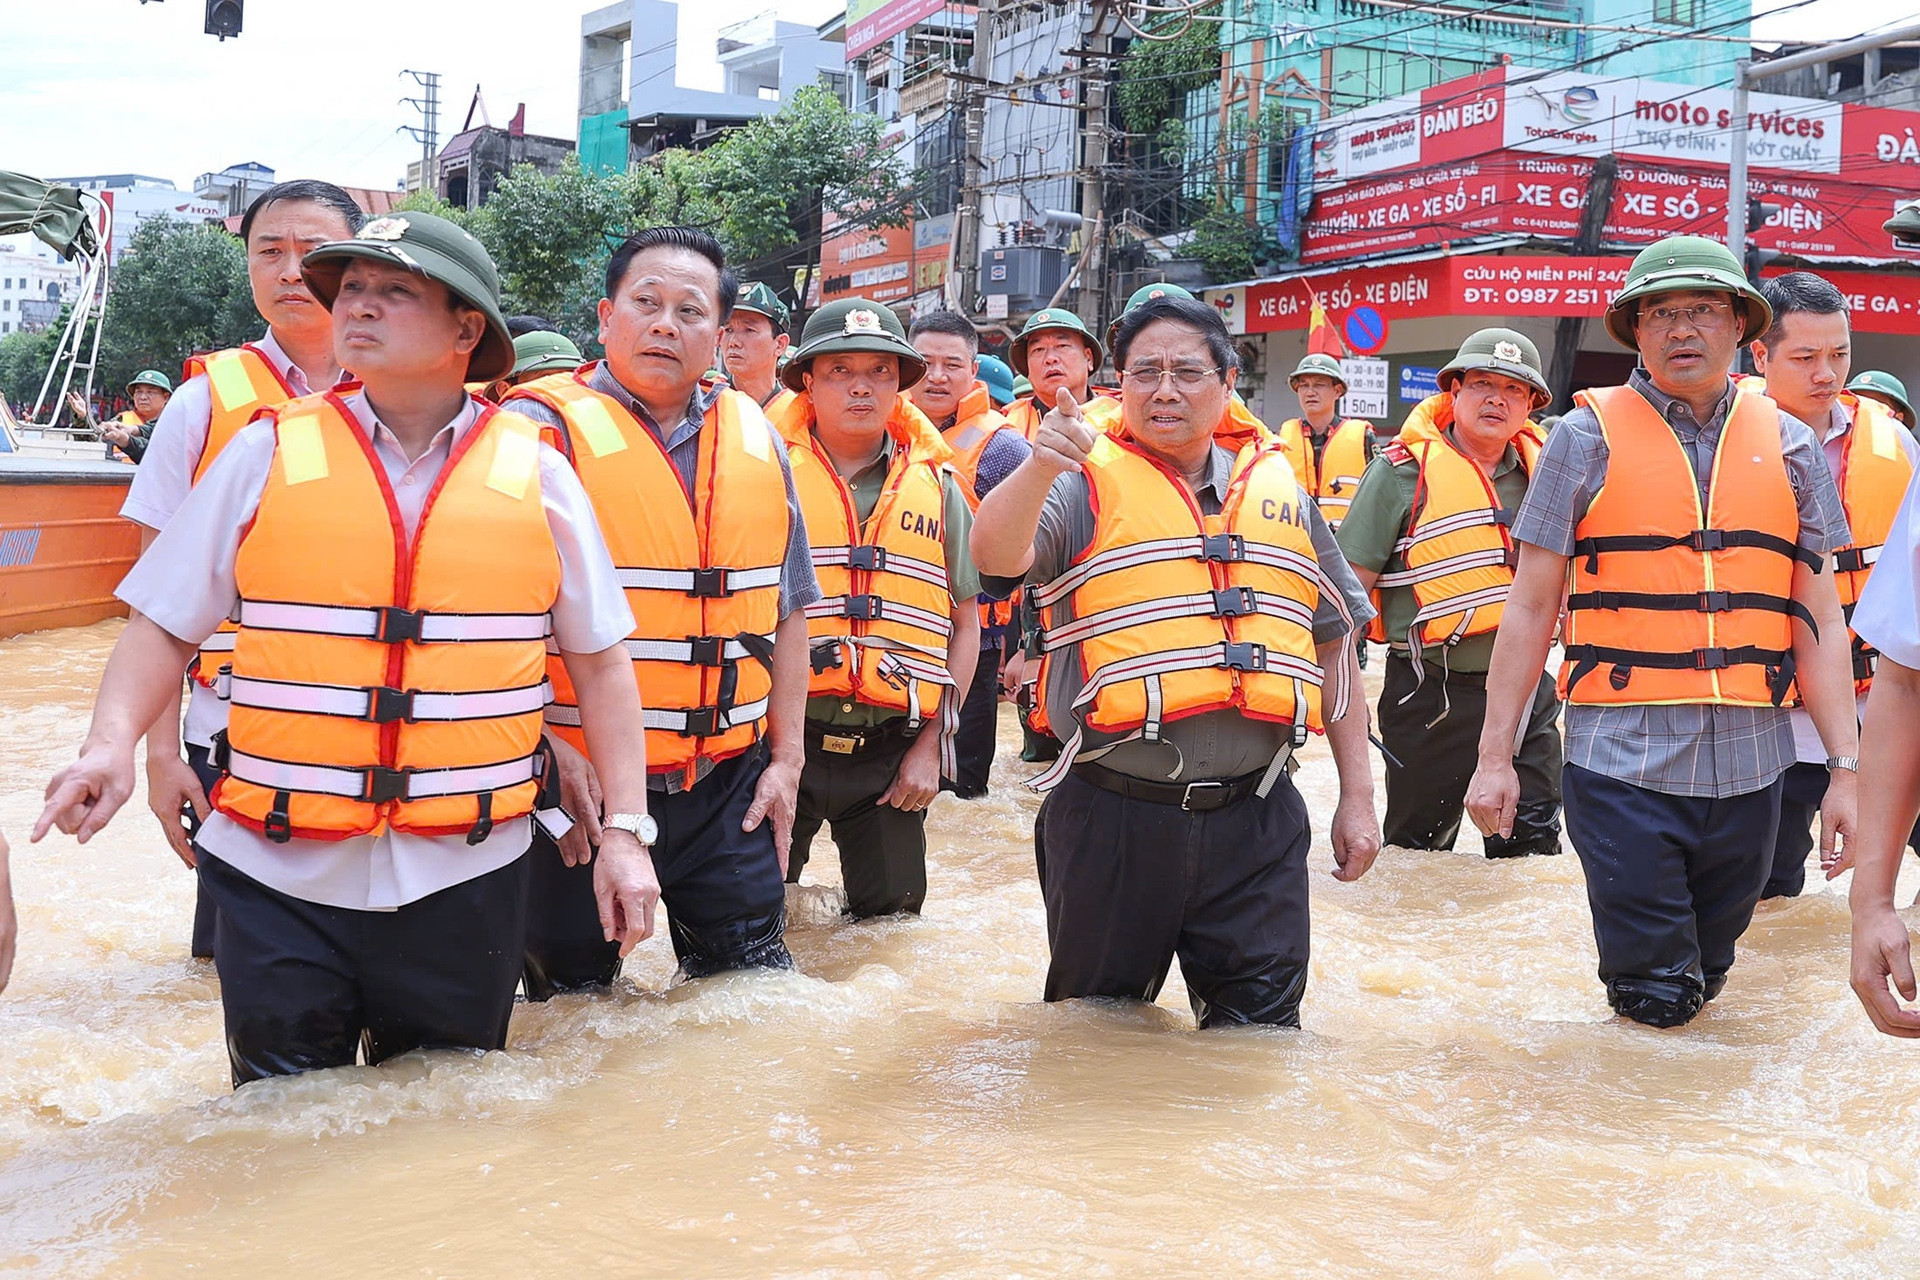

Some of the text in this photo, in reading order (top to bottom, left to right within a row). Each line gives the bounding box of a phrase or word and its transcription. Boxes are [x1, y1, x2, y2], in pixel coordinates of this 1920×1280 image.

[1423, 105, 1459, 138] ĐÀN
[1636, 100, 1824, 139] moto srvices
[1525, 126, 1598, 144] TotalEnergies
[1518, 160, 1567, 175] TRUNG
[1368, 203, 1386, 228] XE
[1389, 203, 1410, 223] GA
[1422, 194, 1442, 218] XE
[1445, 181, 1467, 213] SỐ
[1481, 185, 1497, 207] FI
[1517, 183, 1552, 207] XE
[1623, 192, 1657, 216] XE
[1664, 188, 1700, 219] SỐ
[1463, 266, 1495, 281] CỨU
[1500, 266, 1522, 283] HỘ
[1526, 265, 1563, 281] MIỄN
[1568, 266, 1593, 281] PHÍ
[1259, 298, 1275, 317] XE
[1278, 296, 1298, 315] GA
[1310, 291, 1329, 312] XE
[1331, 280, 1352, 309] SỐ
[1366, 282, 1385, 304] XE
[1389, 274, 1428, 306] ĐIỆN
[1464, 288, 1499, 303] ĐT:
[1505, 288, 1560, 304] 0987
[1564, 289, 1598, 304] 251
[1841, 293, 1866, 311] XE
[1871, 296, 1900, 313] GA
[1352, 399, 1377, 414] 50m
